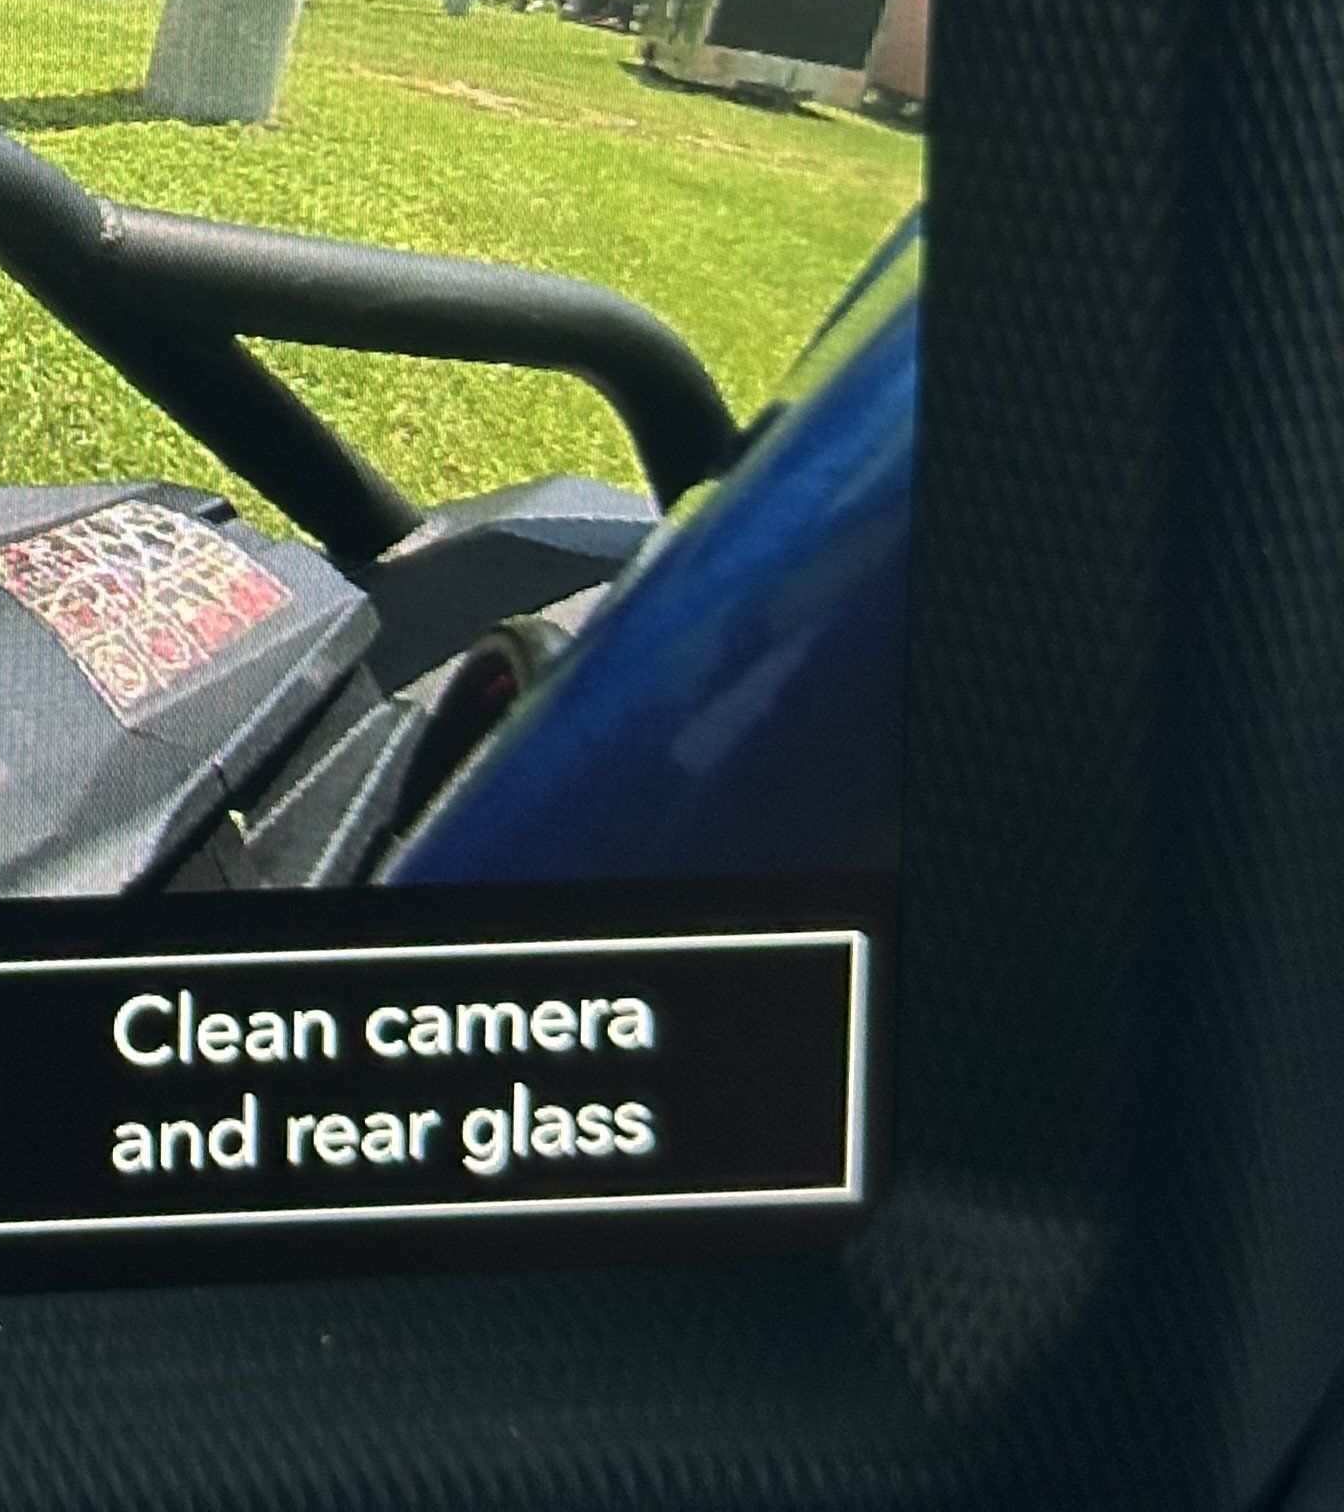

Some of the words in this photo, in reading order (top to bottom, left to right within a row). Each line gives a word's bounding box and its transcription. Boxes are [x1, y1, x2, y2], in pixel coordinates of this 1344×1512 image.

[112, 989, 339, 1067] Clean
[364, 996, 656, 1058] camera
[111, 1092, 259, 1174] and
[285, 1108, 443, 1166] rear
[461, 1080, 657, 1176] glass
